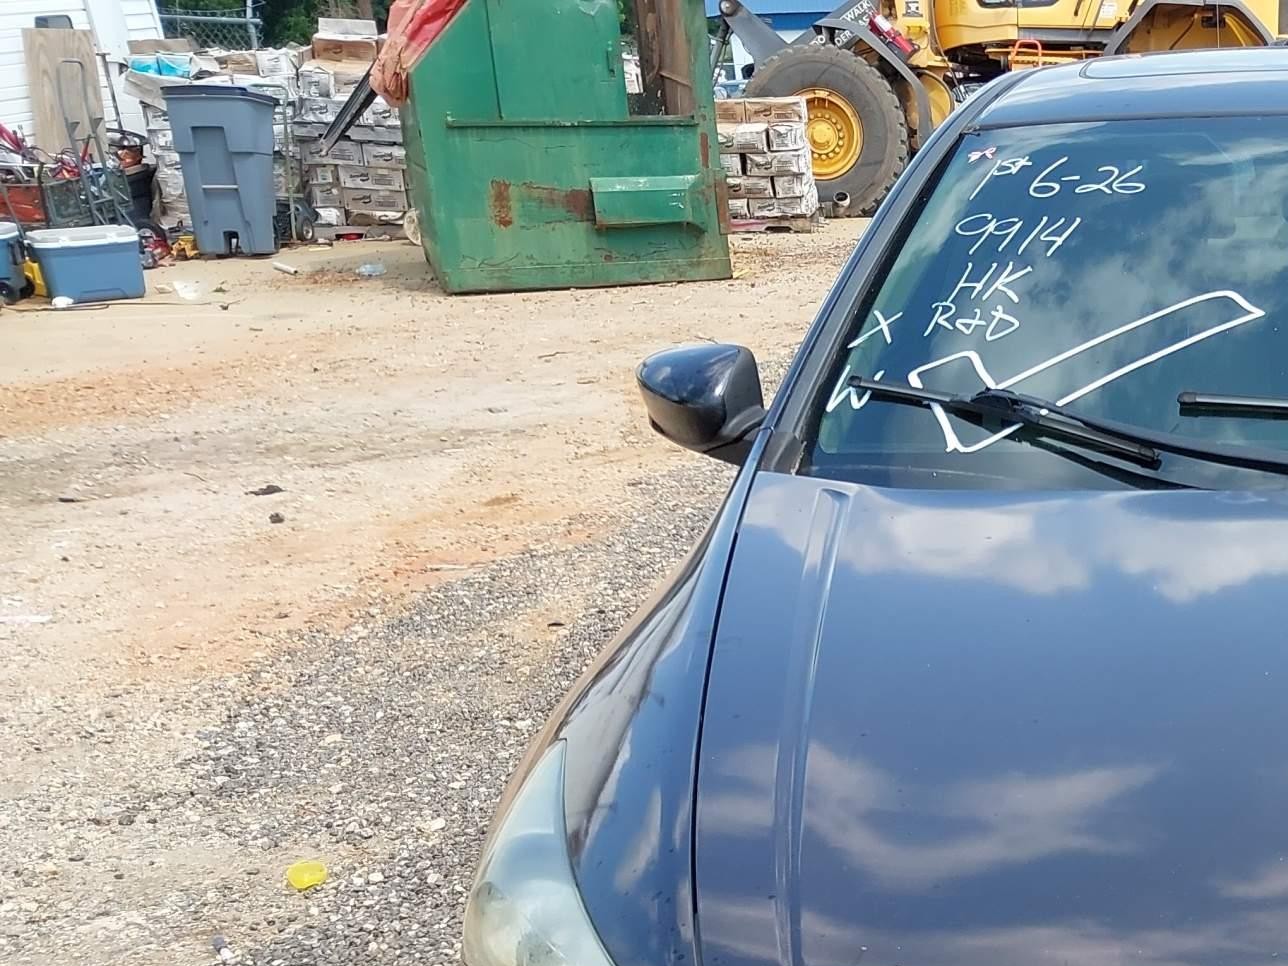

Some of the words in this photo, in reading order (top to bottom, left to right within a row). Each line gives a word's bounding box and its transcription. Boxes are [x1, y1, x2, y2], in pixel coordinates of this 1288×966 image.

[1028, 156, 1146, 198] 6-26
[954, 213, 1082, 256] 9914
[945, 260, 1033, 304] HK
